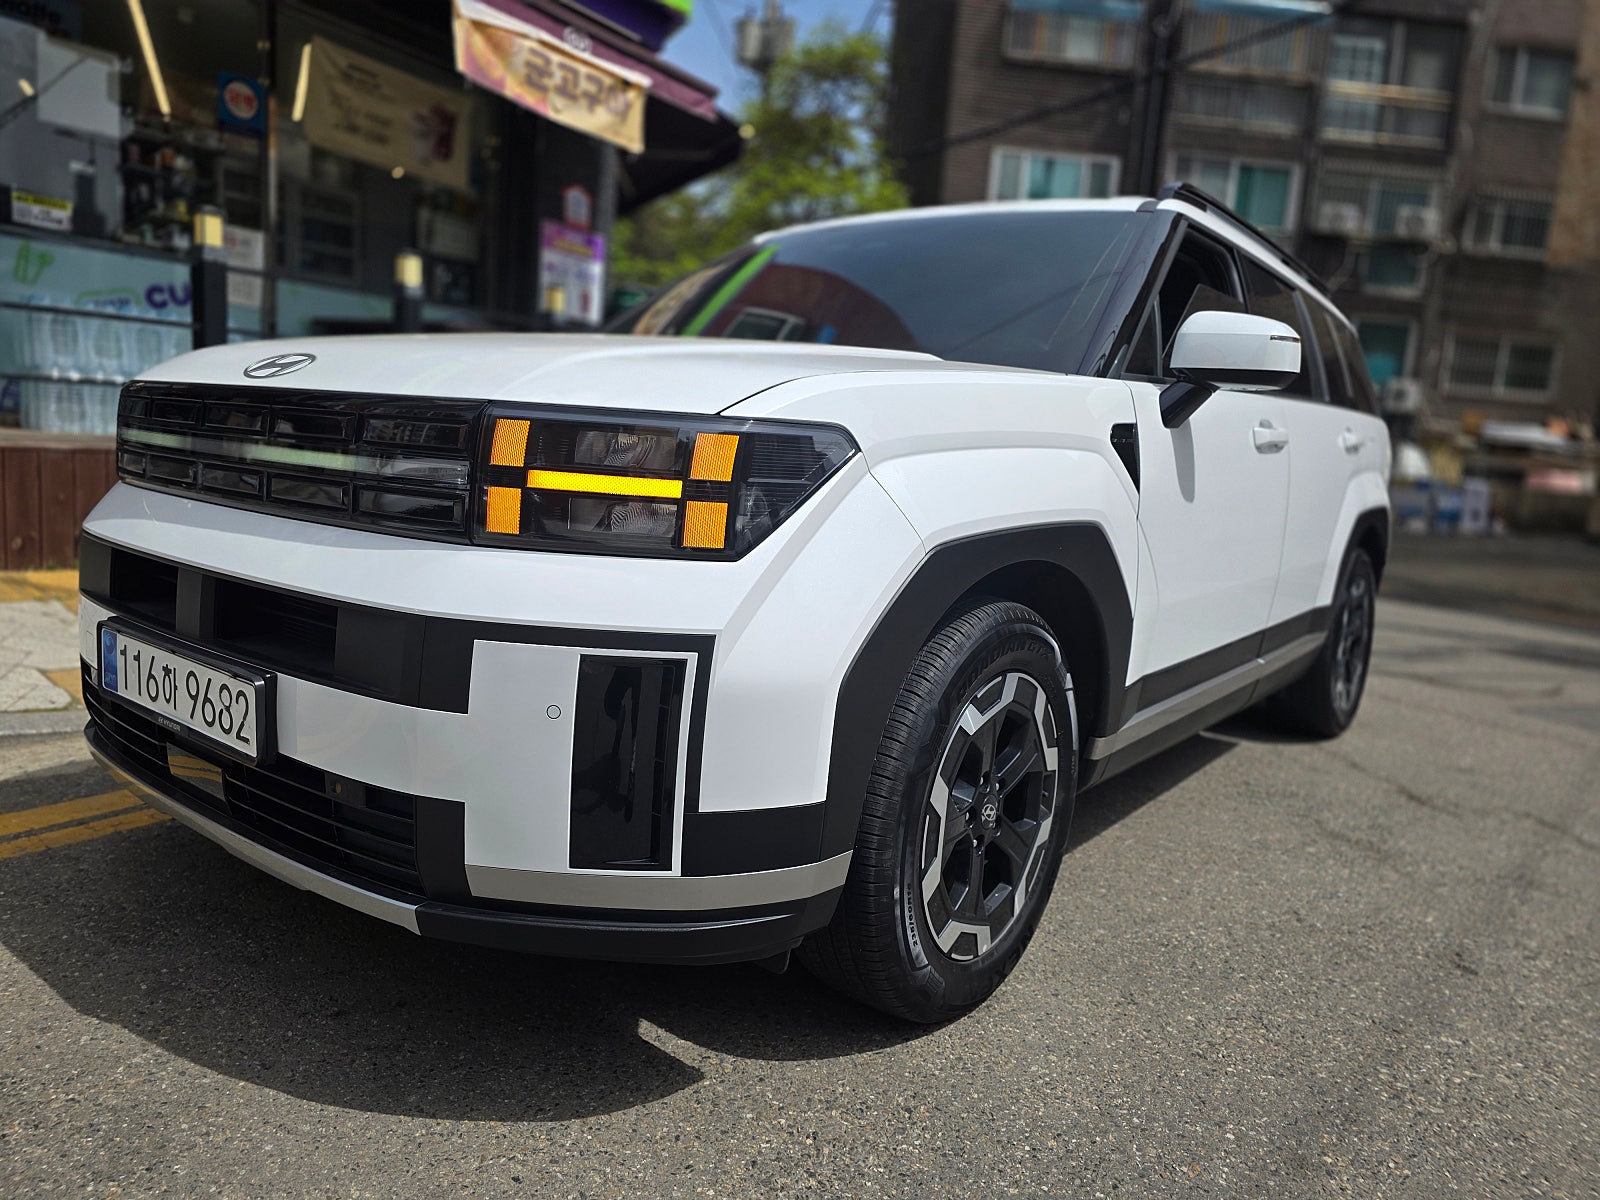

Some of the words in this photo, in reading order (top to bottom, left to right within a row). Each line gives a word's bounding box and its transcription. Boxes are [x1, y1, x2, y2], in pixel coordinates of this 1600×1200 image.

[524, 47, 633, 122] 군고구마
[145, 284, 191, 310] CU
[119, 644, 179, 711] 116하
[185, 669, 251, 745] 9682
